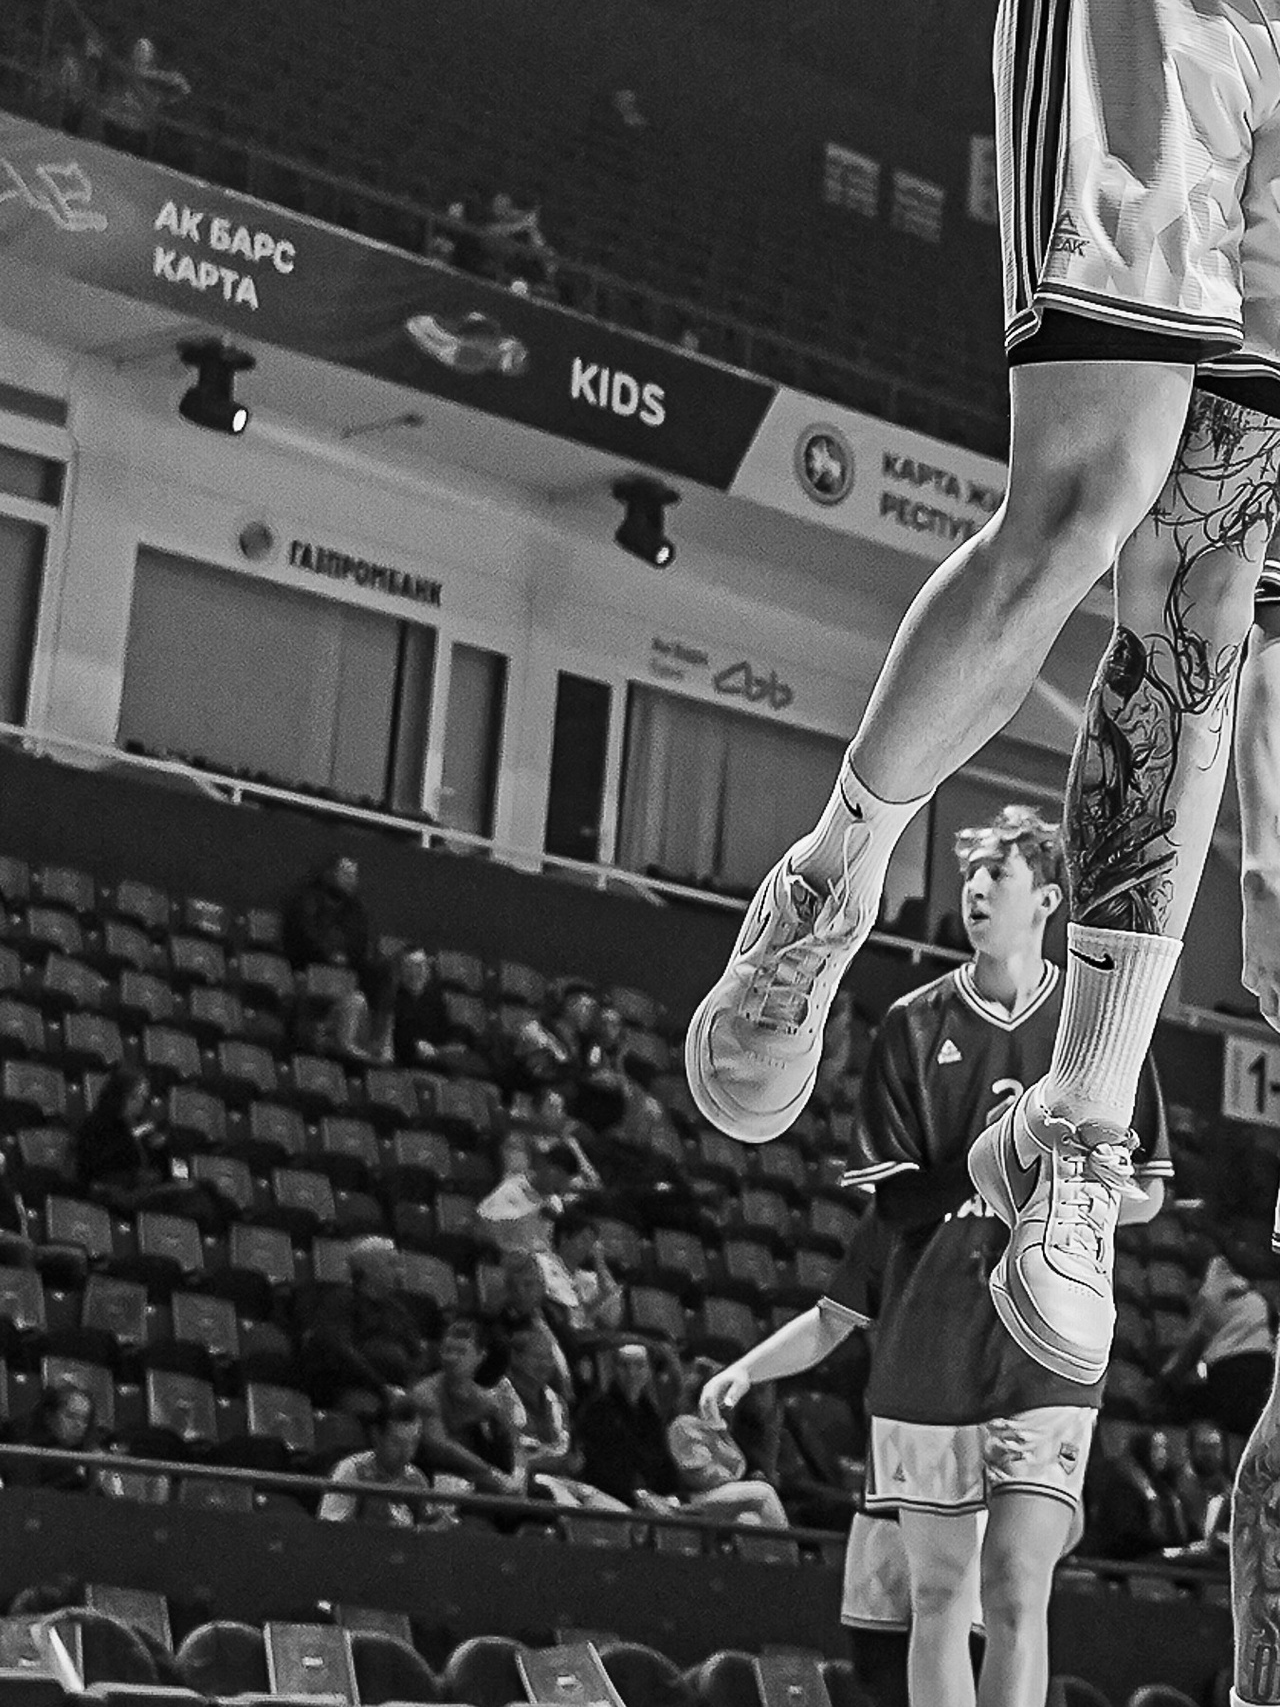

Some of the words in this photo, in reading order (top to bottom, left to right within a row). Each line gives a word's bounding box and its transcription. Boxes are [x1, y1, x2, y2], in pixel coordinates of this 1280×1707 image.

[154, 200, 203, 243] АК
[210, 217, 296, 274] БАРС
[152, 246, 259, 310] КАРТА
[571, 356, 666, 426] KIDS
